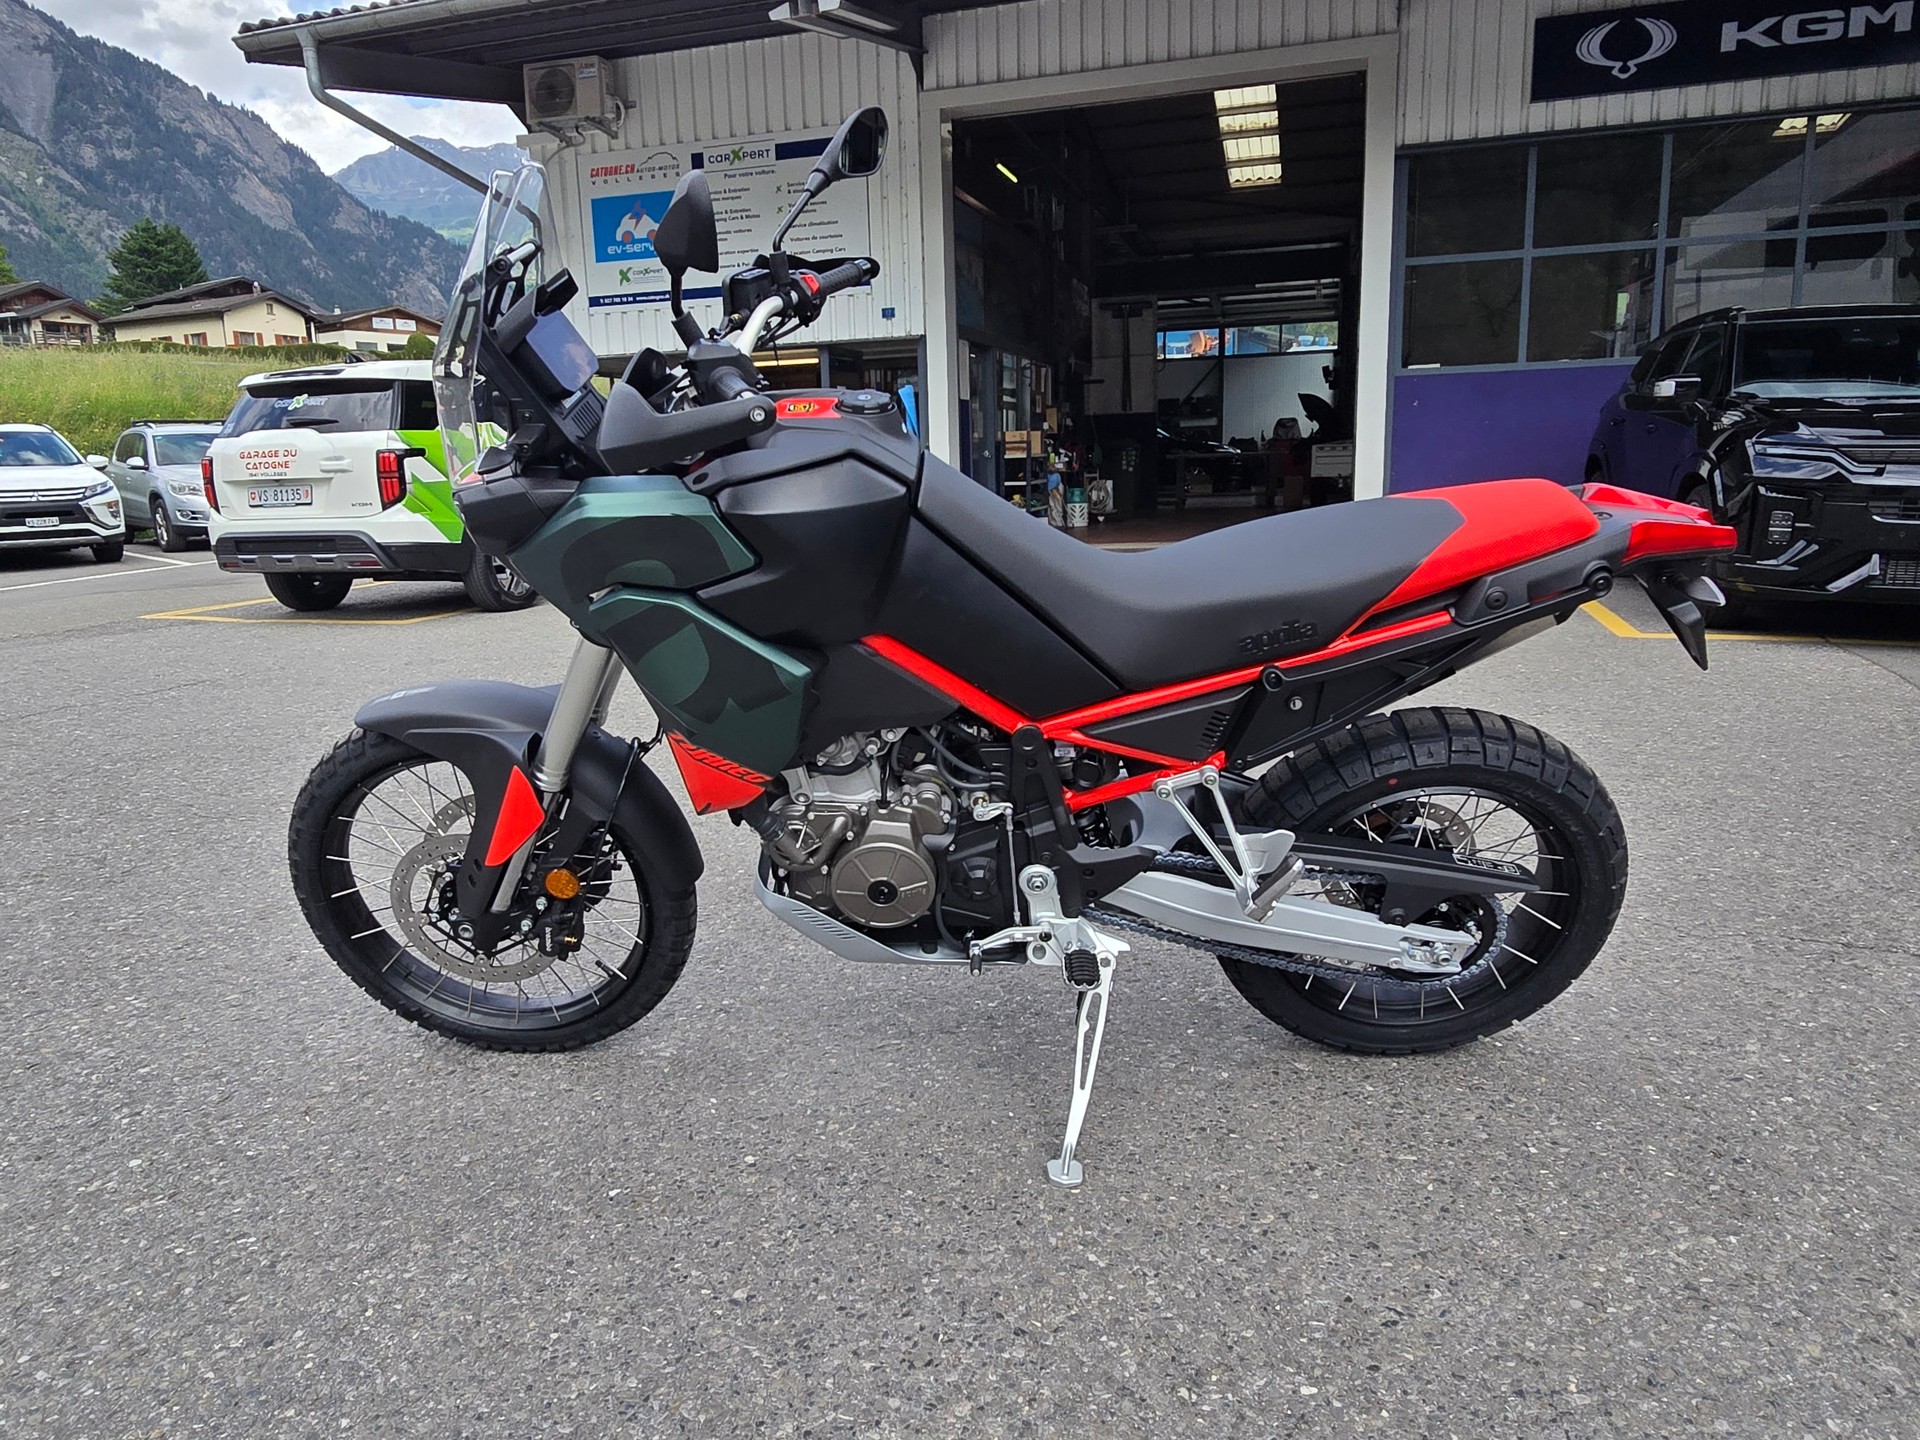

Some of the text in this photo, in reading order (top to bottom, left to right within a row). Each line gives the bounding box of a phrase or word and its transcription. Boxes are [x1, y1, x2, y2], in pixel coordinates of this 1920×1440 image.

[1720, 1, 1914, 52] KGM
[590, 163, 680, 178] CATOGNE.CH AUTOS-MOTOS
[239, 449, 298, 460] GARAGE DU
[245, 460, 290, 470] CATOGNE
[273, 488, 302, 502] 81135
[1238, 619, 1319, 655] aprilia
